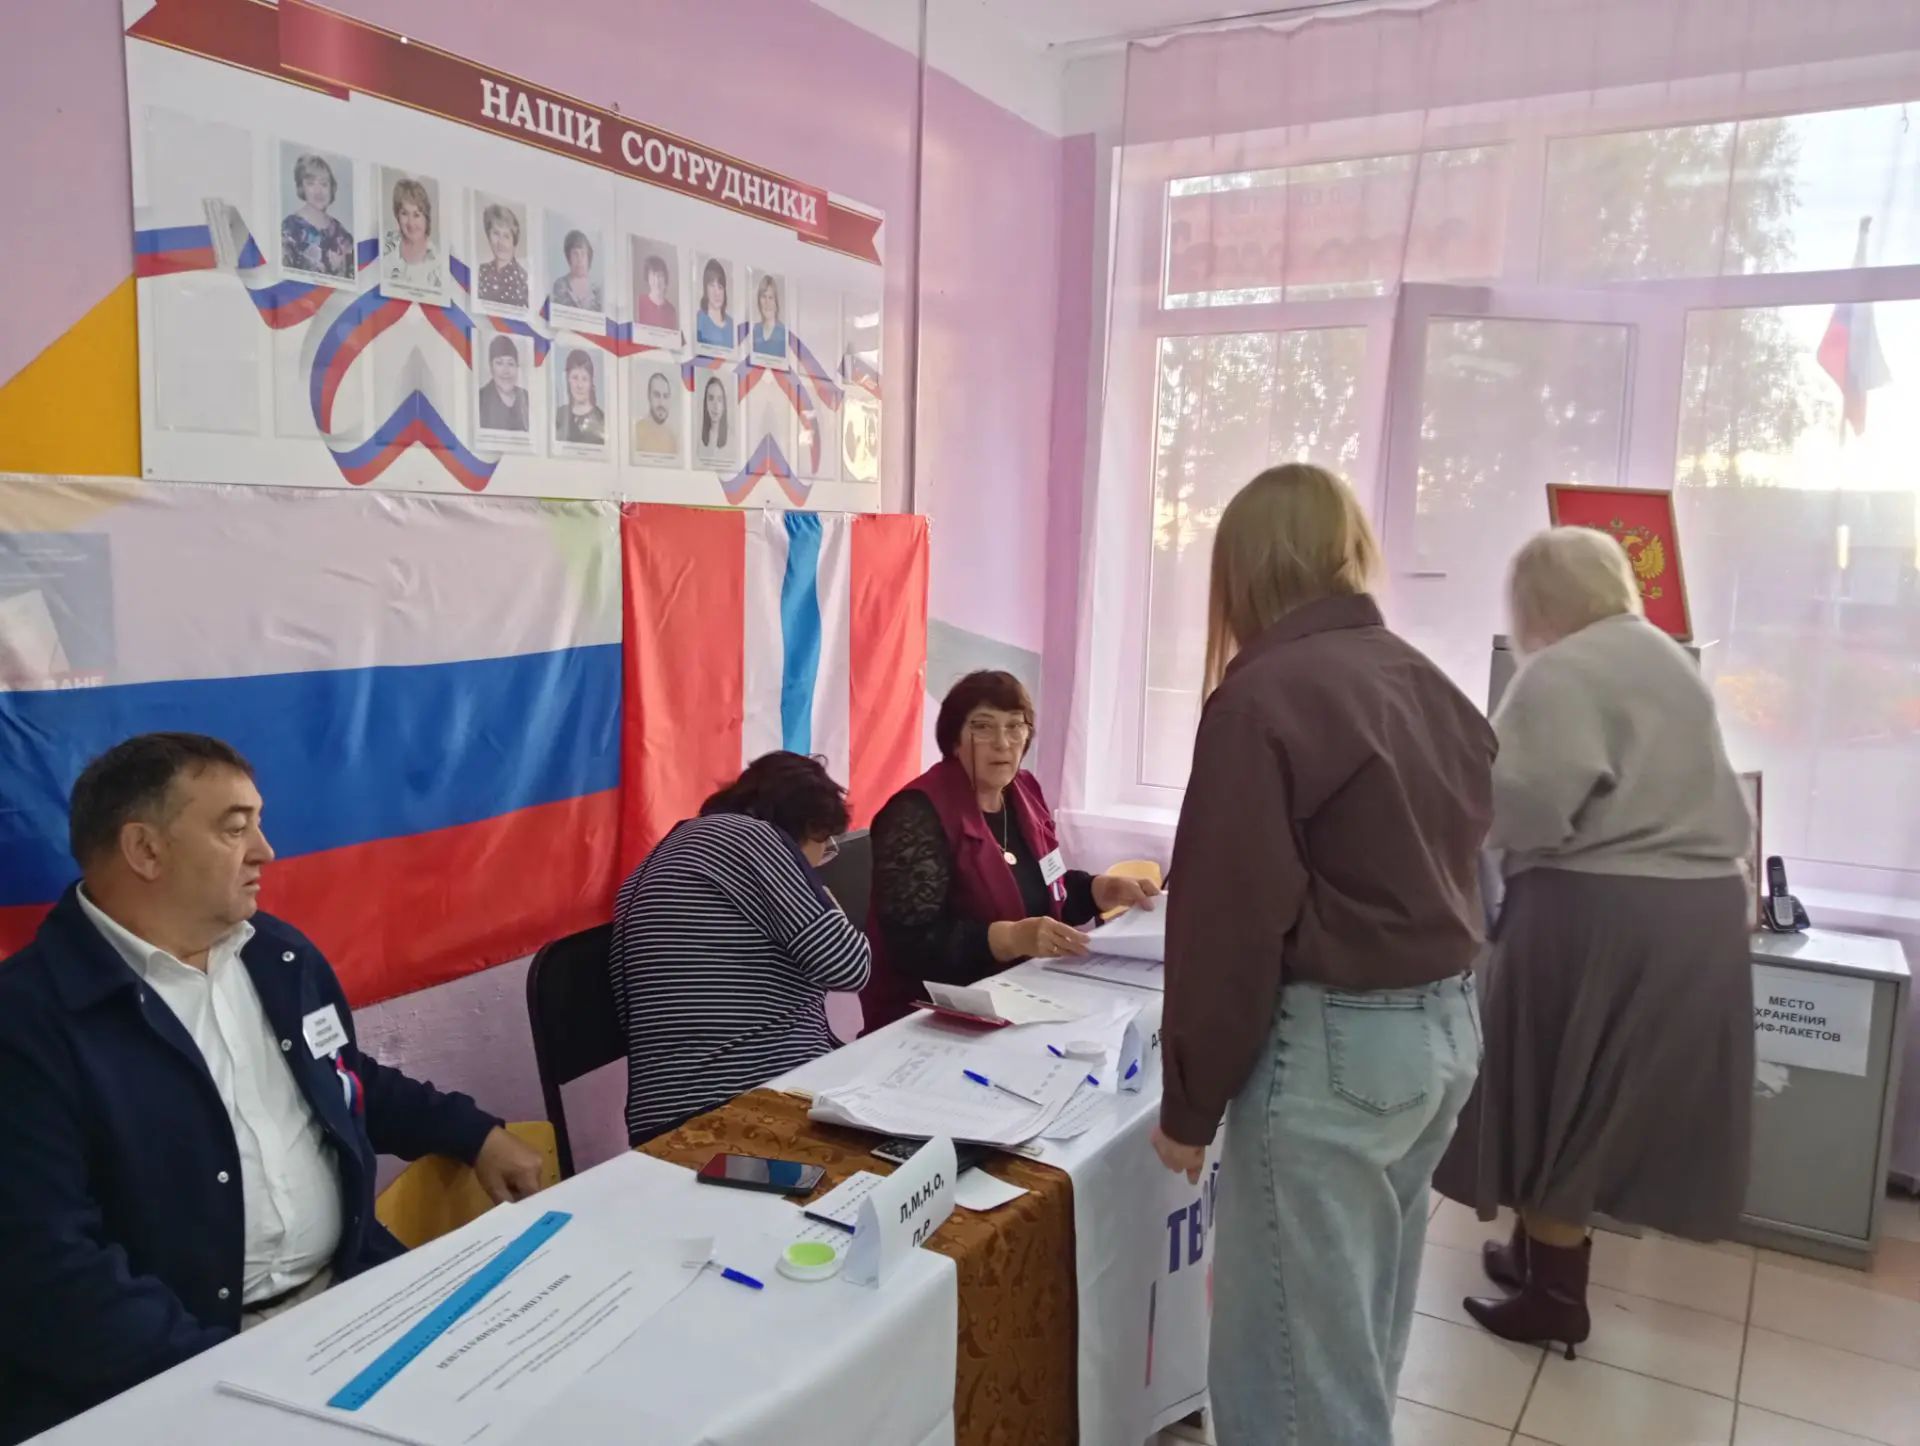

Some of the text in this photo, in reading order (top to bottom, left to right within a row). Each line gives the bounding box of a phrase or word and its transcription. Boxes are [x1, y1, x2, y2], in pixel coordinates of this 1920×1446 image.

[480, 78, 818, 226] НАШИ СОТРУДНИКИ
[1768, 995, 1815, 1011] МЕСТО
[1754, 1007, 1826, 1027] ХРАНЕНИЯ
